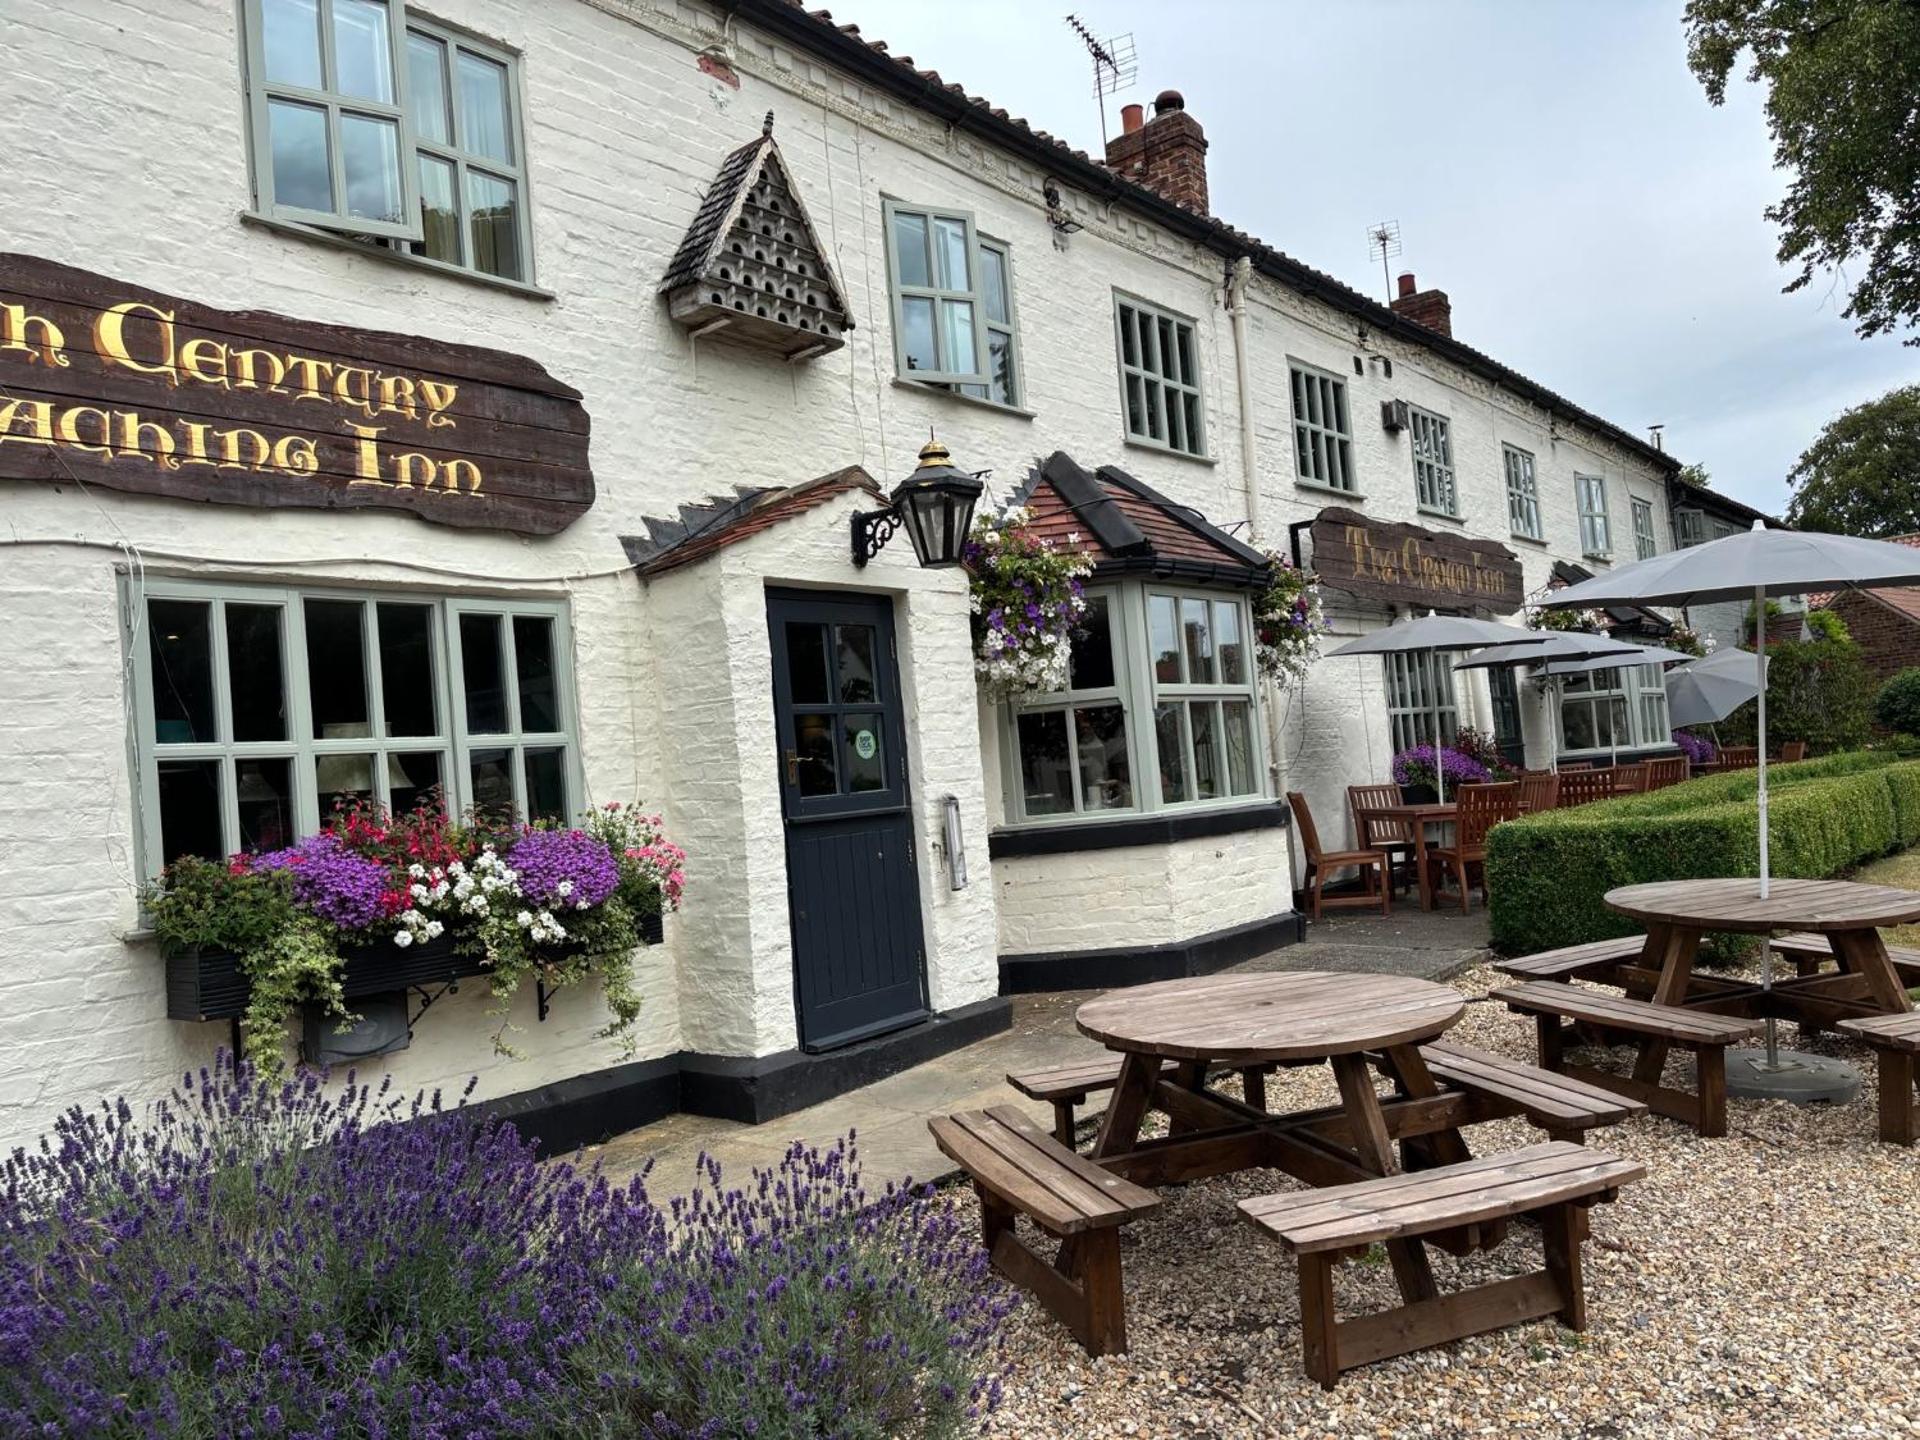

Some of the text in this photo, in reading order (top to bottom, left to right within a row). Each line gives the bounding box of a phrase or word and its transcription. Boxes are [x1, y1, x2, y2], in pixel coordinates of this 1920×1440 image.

[341, 419, 485, 497] Inn
[1345, 526, 1400, 584] The
[1472, 551, 1505, 595] Inn
